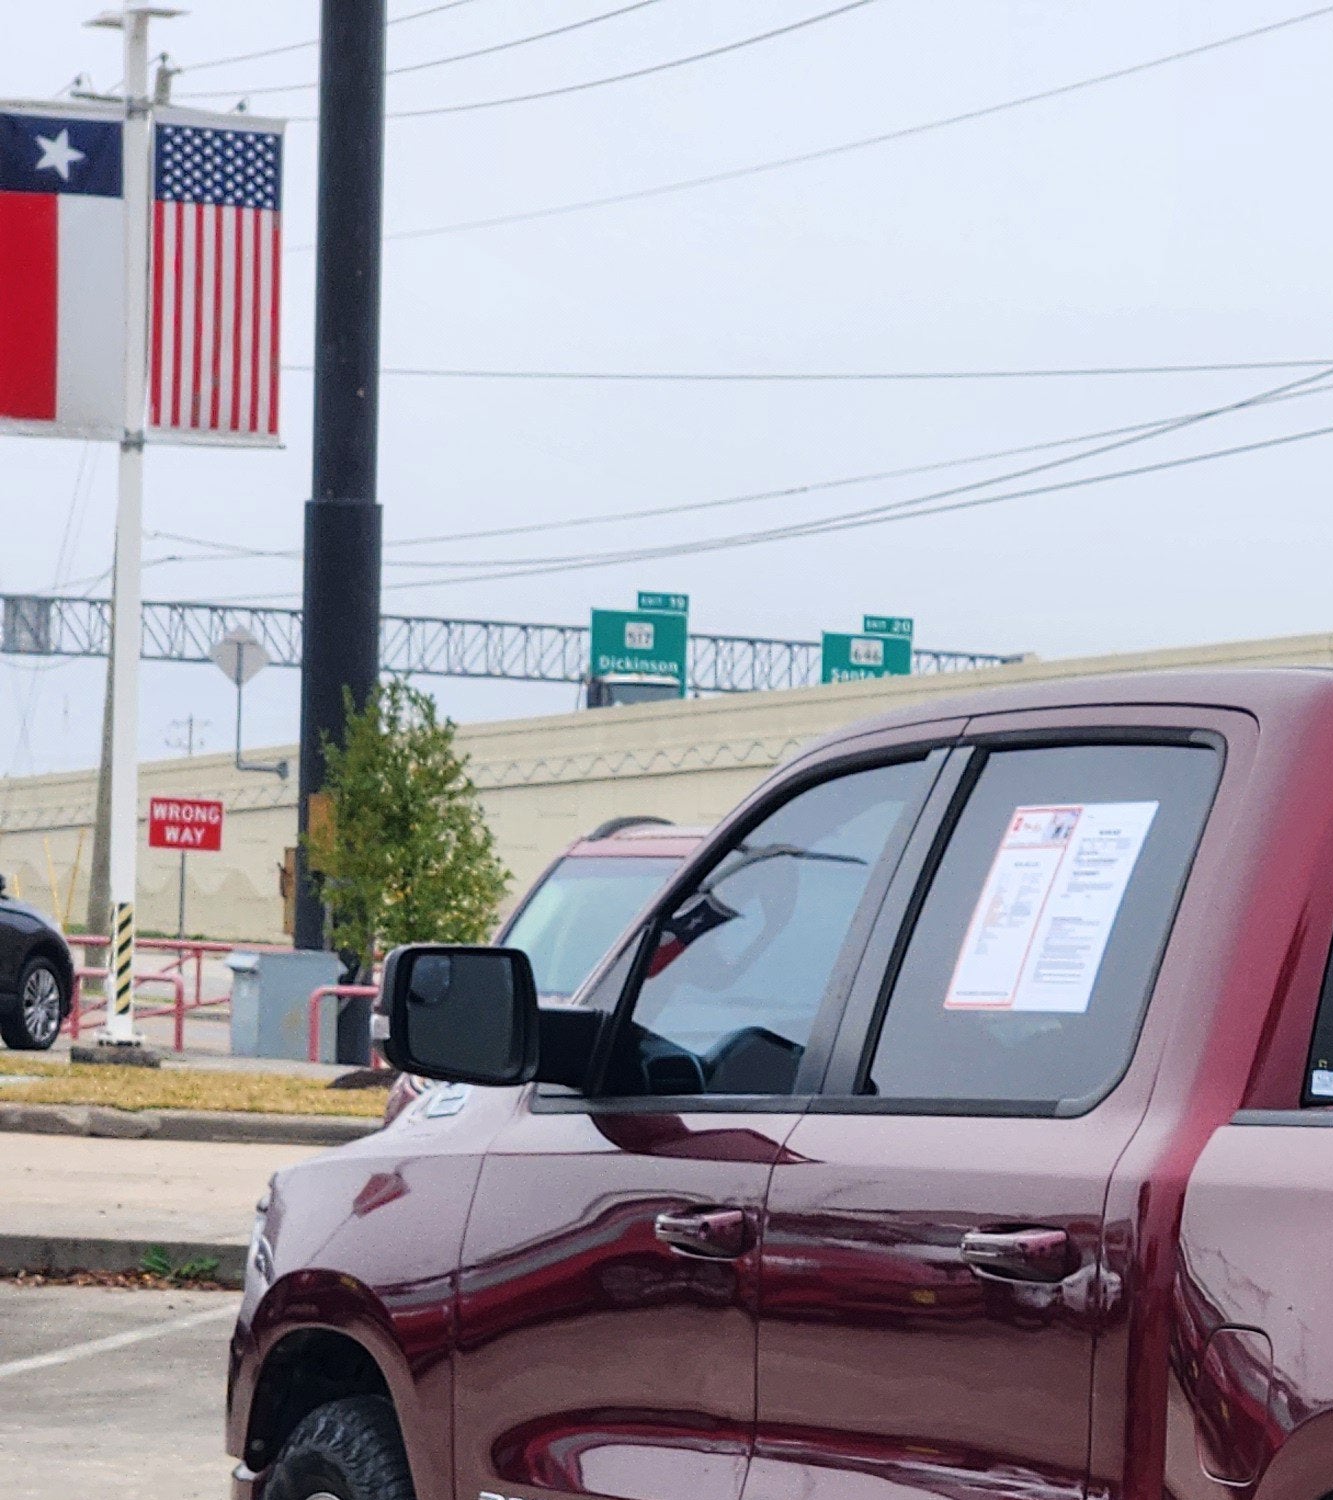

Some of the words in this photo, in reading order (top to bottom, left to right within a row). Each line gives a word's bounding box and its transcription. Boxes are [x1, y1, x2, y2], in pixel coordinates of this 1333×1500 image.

[600, 655, 679, 673] Dickinson
[153, 803, 219, 824] WRONG
[165, 826, 205, 843] WAY
